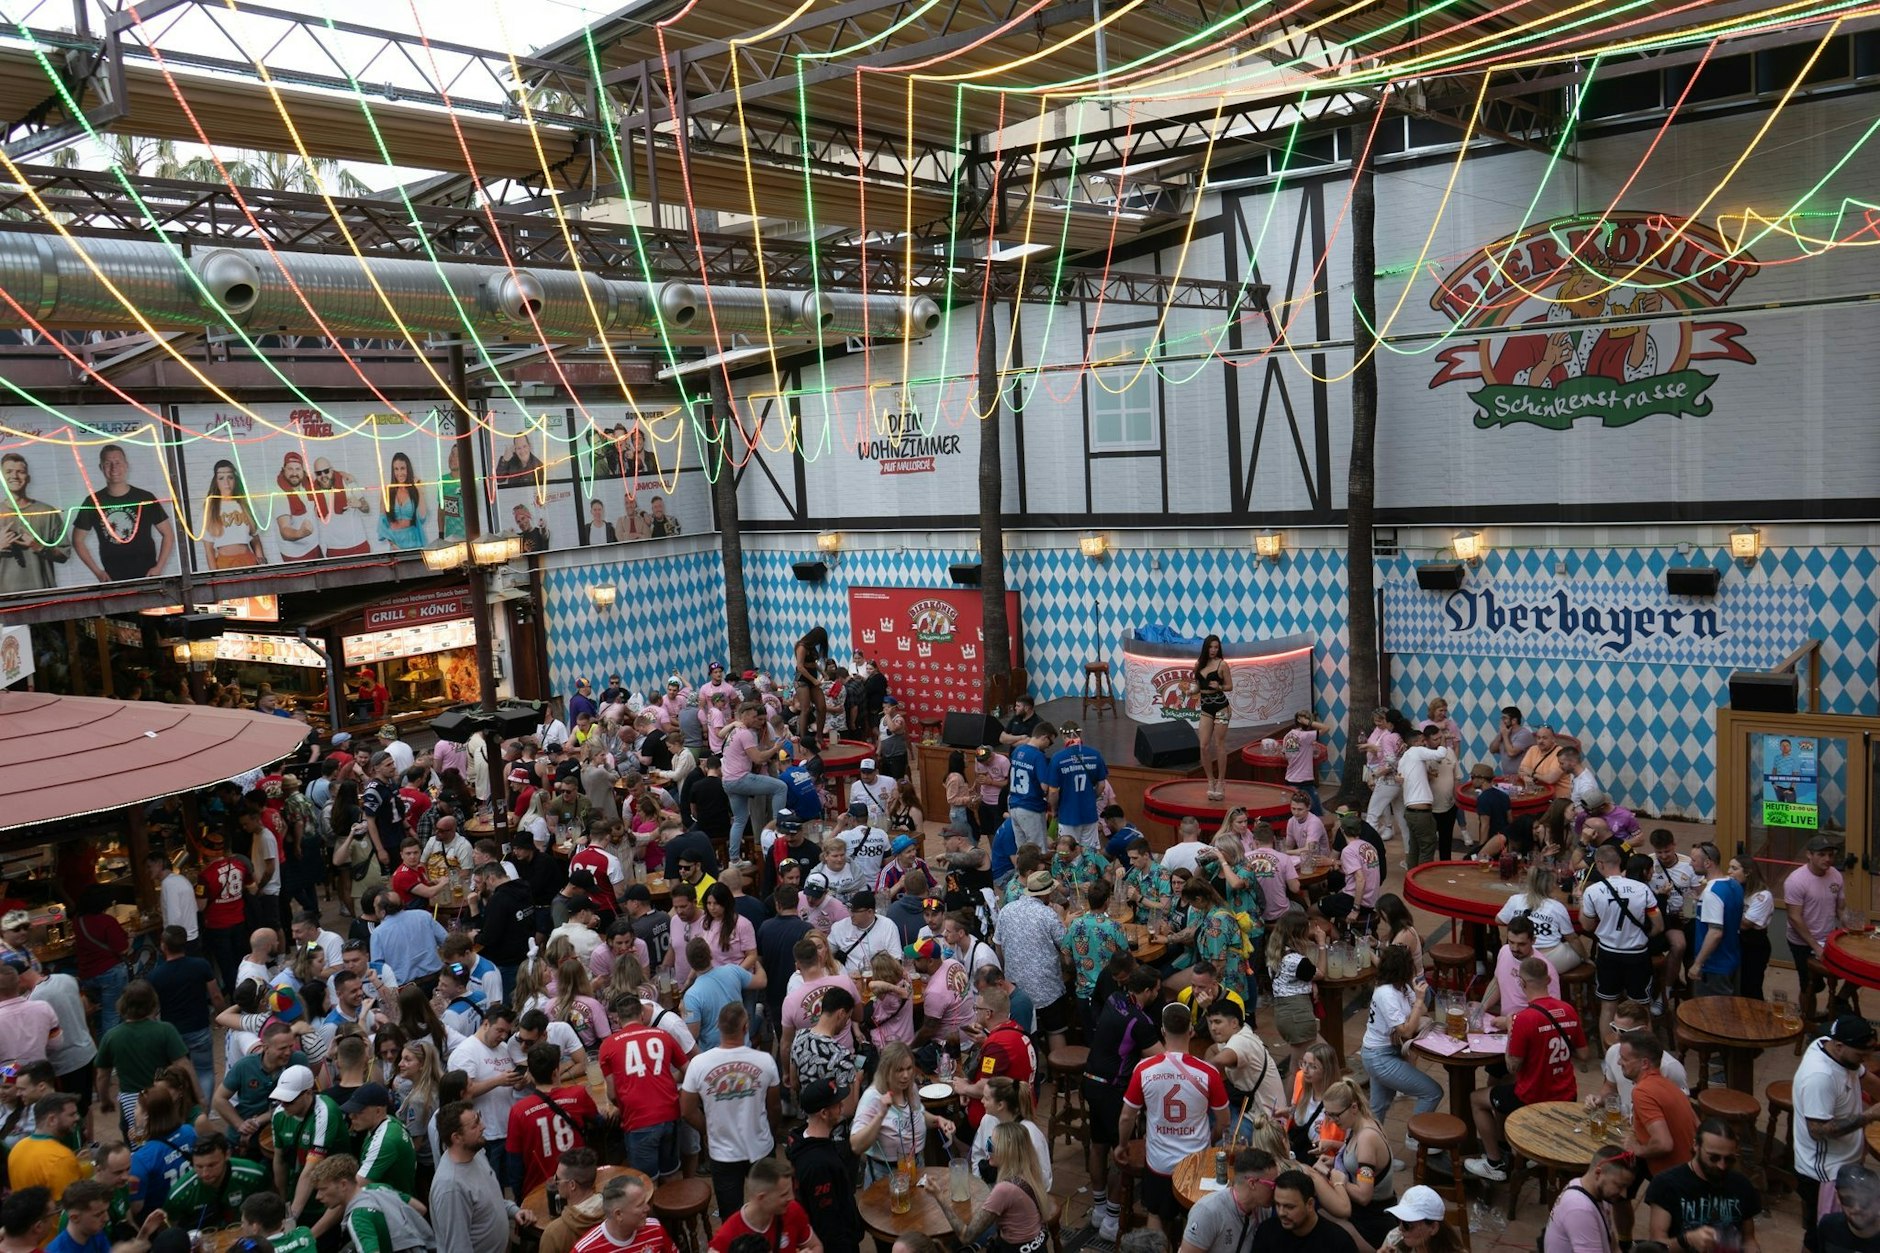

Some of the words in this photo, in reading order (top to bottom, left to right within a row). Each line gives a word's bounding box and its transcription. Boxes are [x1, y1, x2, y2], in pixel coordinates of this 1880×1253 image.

[1445, 219, 1732, 319] BIERKÖNIG
[1494, 381, 1690, 419] Schinkenstrasse
[888, 412, 922, 433] DEIN
[858, 435, 961, 461] WOHNZIMMER
[410, 592, 436, 602] leckeren
[436, 590, 455, 599] Snack
[371, 609, 406, 623] GRILL
[420, 602, 457, 617] KÖNIG
[1444, 587, 1728, 654] Oberbayern
[1074, 774, 1087, 792] 17
[1765, 803, 1789, 812] HEUTE
[1790, 814, 1816, 826] LIVE!
[1608, 897, 1630, 932] 7
[624, 1037, 665, 1078] 49
[1548, 1036, 1571, 1065] 25
[1163, 1083, 1187, 1124] 6
[536, 1113, 575, 1158] 18
[1156, 1125, 1195, 1135] KIMMICH
